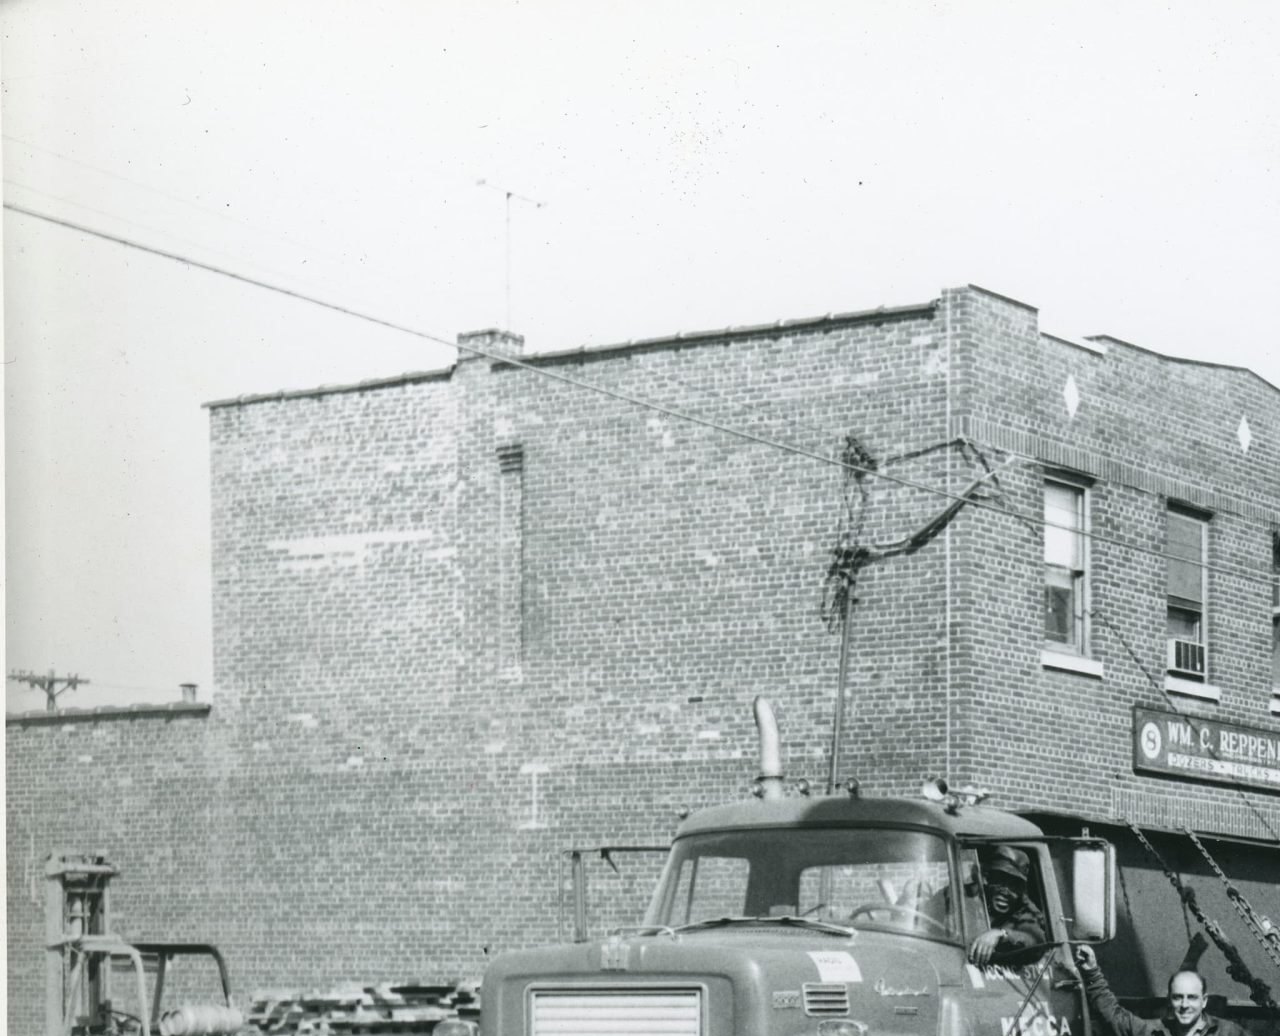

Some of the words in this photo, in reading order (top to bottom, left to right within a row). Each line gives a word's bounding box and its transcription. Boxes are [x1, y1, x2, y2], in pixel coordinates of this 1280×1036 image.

[1168, 721, 1194, 747] WM.
[1200, 728, 1214, 750] C.
[1231, 764, 1270, 779] TRUCKS
